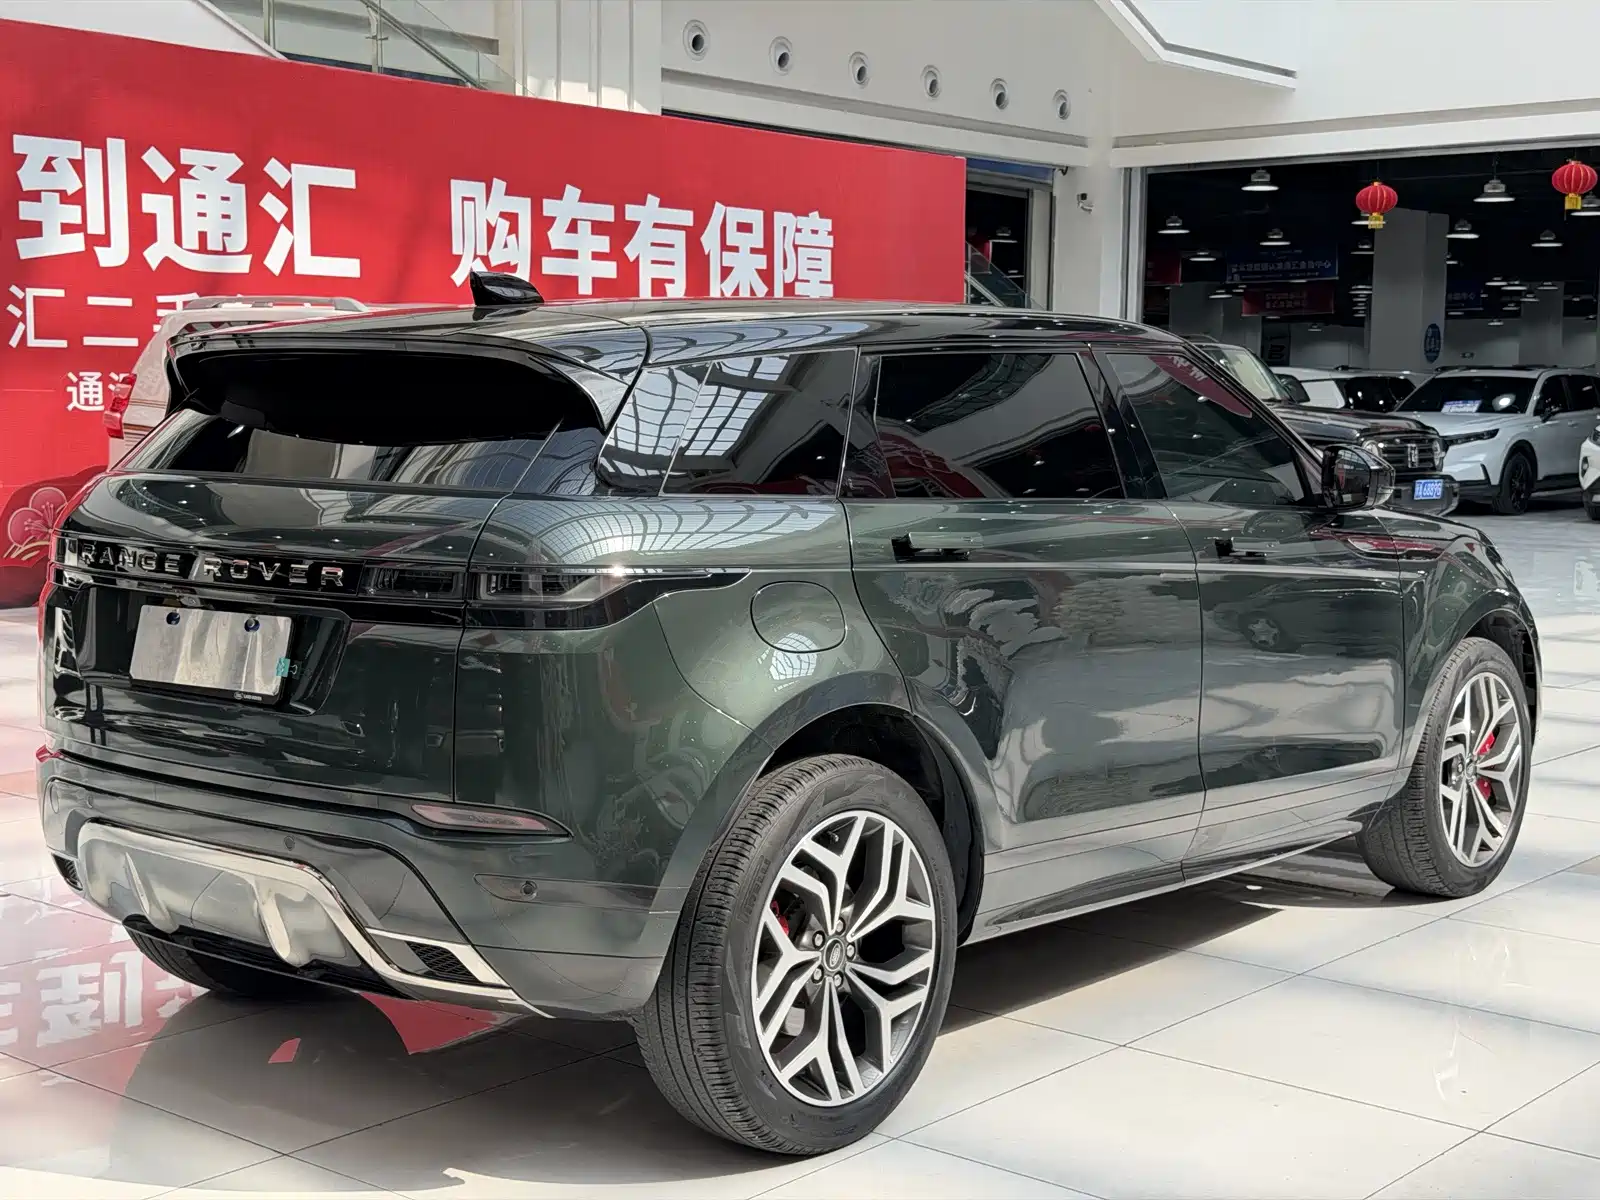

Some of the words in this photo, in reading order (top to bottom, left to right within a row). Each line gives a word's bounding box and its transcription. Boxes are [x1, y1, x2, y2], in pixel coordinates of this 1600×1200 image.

[12, 134, 361, 279] 到通汇
[450, 178, 834, 298] 购车有保障
[81, 539, 182, 574] RANGE
[202, 556, 345, 588] ROVER
